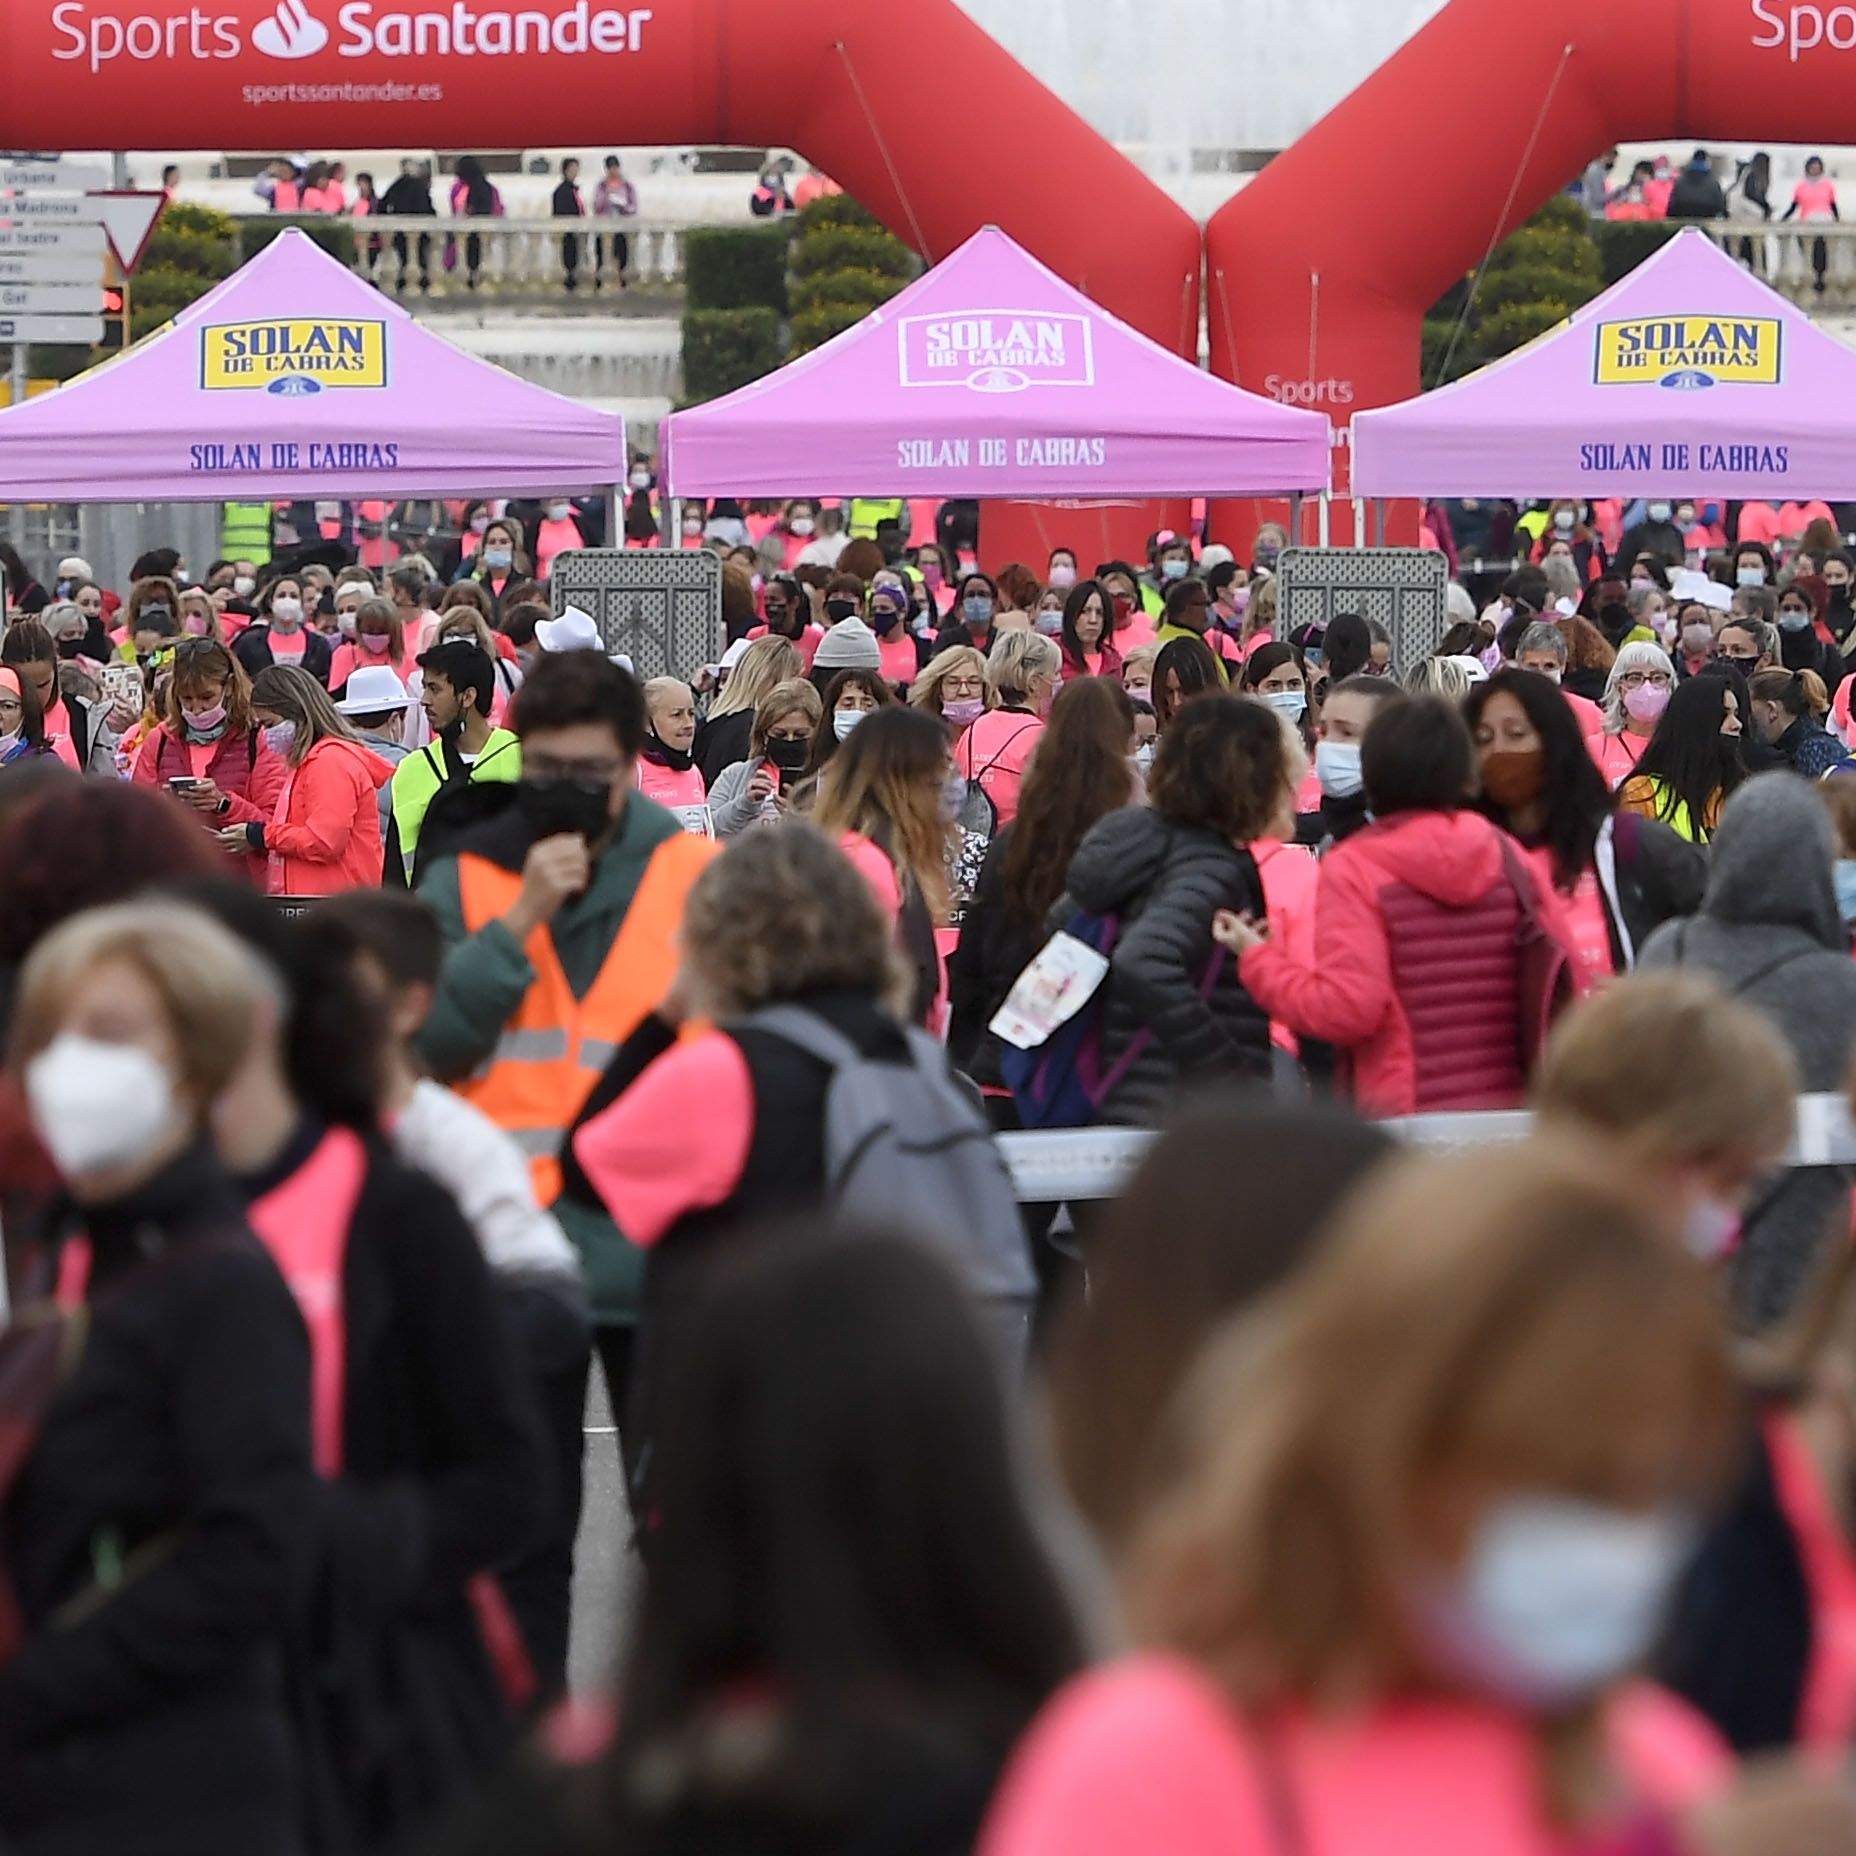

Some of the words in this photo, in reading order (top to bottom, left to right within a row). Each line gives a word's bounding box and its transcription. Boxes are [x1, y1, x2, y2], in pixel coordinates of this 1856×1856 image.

[50, 2, 241, 73] Sports
[337, 0, 652, 57] Santander
[242, 82, 442, 105] sportssantander.es
[224, 356, 253, 373] DE
[266, 355, 364, 371] CABRAS
[927, 350, 958, 367] DE
[968, 350, 1065, 367] CABRAS
[1617, 352, 1647, 368] DE
[1660, 350, 1758, 367] CABRAS
[1264, 374, 1354, 404] Sports
[272, 444, 299, 469] DE
[309, 443, 398, 469] CABRAS
[978, 440, 1007, 467] DE
[1016, 438, 1106, 466] CABRAS
[1662, 444, 1689, 471] DE
[1699, 444, 1788, 472] CABRAS
